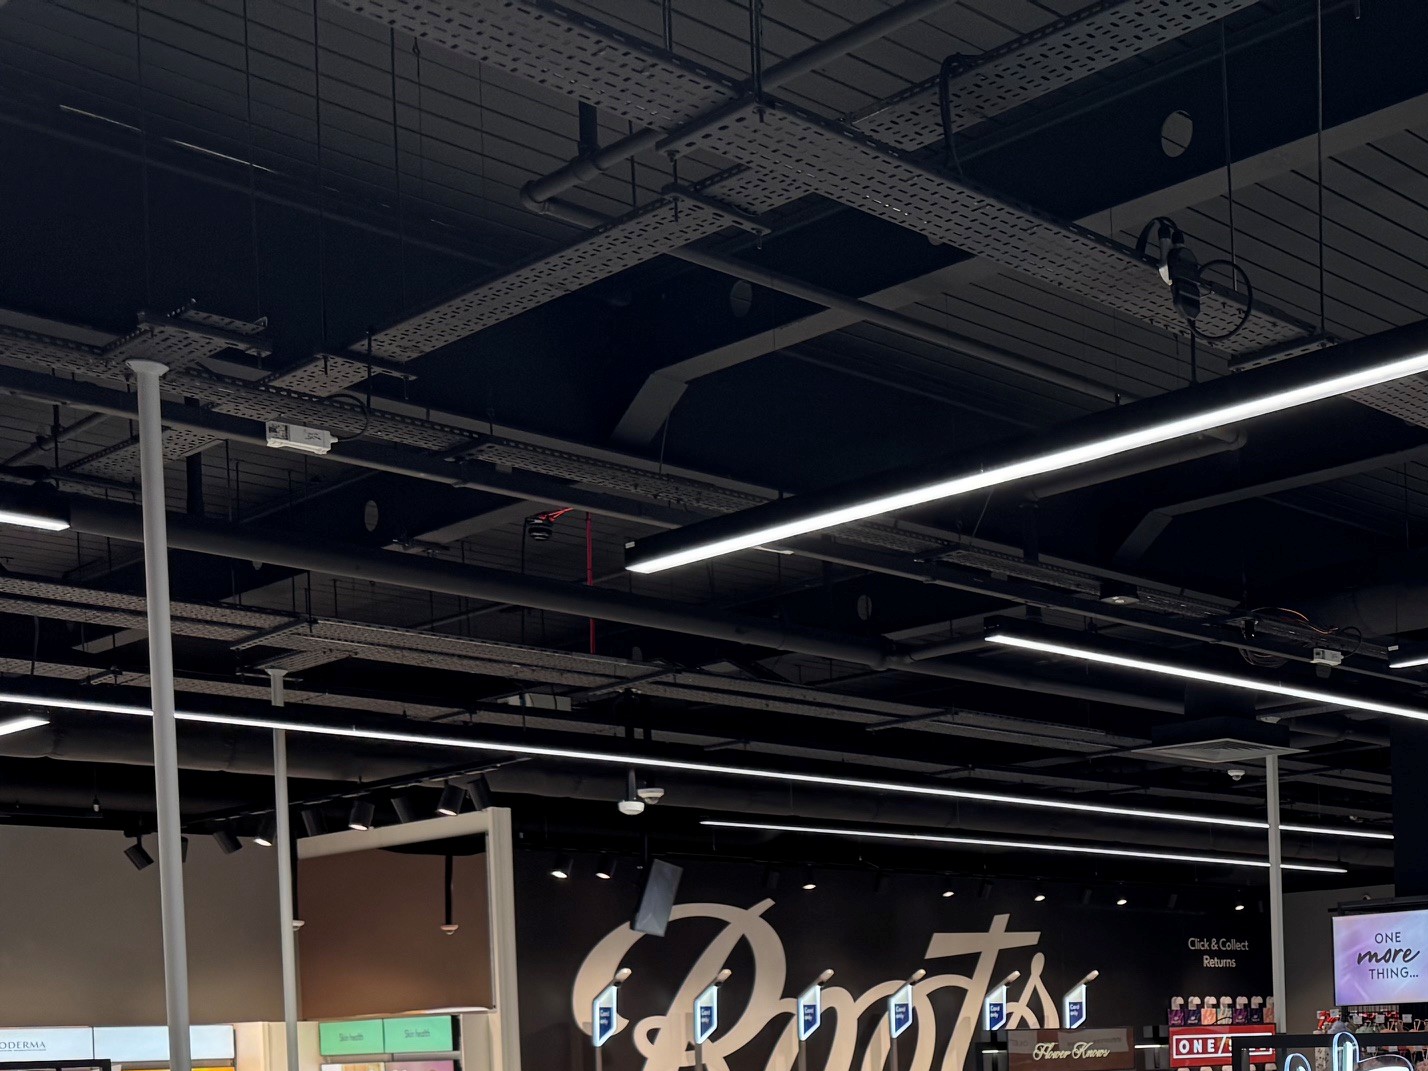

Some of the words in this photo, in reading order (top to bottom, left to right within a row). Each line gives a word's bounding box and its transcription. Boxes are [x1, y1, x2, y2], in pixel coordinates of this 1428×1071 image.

[1188, 937, 1210, 950] Click
[1210, 938, 1218, 950] &
[1219, 938, 1249, 951] Collect
[1374, 931, 1402, 945] ONE
[1203, 955, 1236, 968] Returns
[1357, 945, 1420, 966] more
[1368, 966, 1419, 980] THING...
[1032, 1042, 1070, 1061] Flower
[1071, 1041, 1111, 1059] Knows
